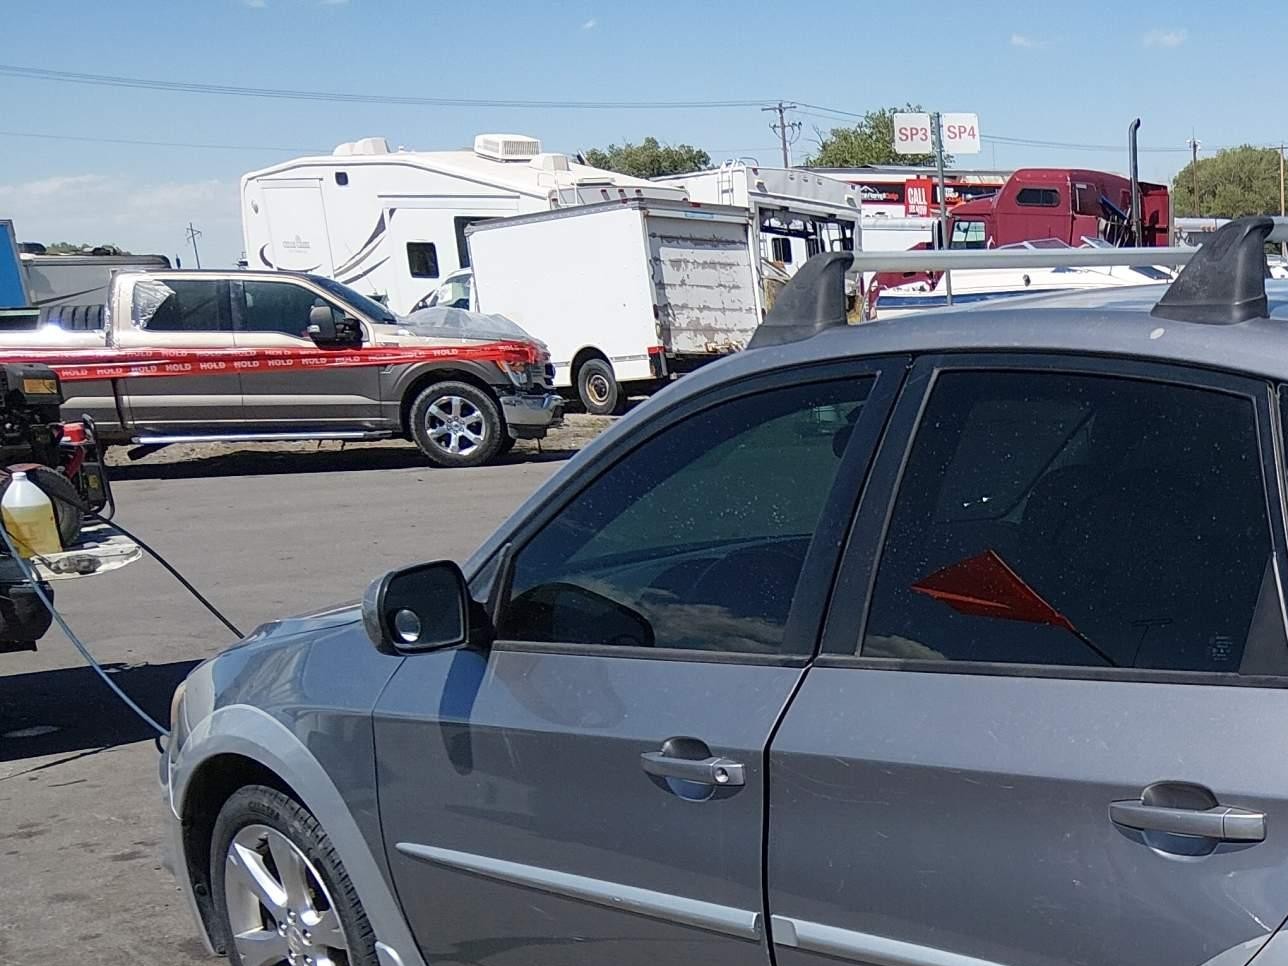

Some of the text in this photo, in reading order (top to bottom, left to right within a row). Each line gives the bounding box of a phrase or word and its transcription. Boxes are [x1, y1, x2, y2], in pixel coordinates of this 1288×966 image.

[898, 126, 929, 142] SP3
[947, 124, 977, 140] SP4
[907, 187, 928, 205] CALL
[62, 369, 88, 377] HOLD
[131, 365, 158, 374] HOLD
[165, 363, 192, 372] HOLD
[200, 362, 226, 370] HOLD
[233, 361, 260, 369] HOLD
[267, 359, 294, 367] HOLD
[301, 357, 327, 365] HOLD
[432, 349, 459, 357] HOLD
